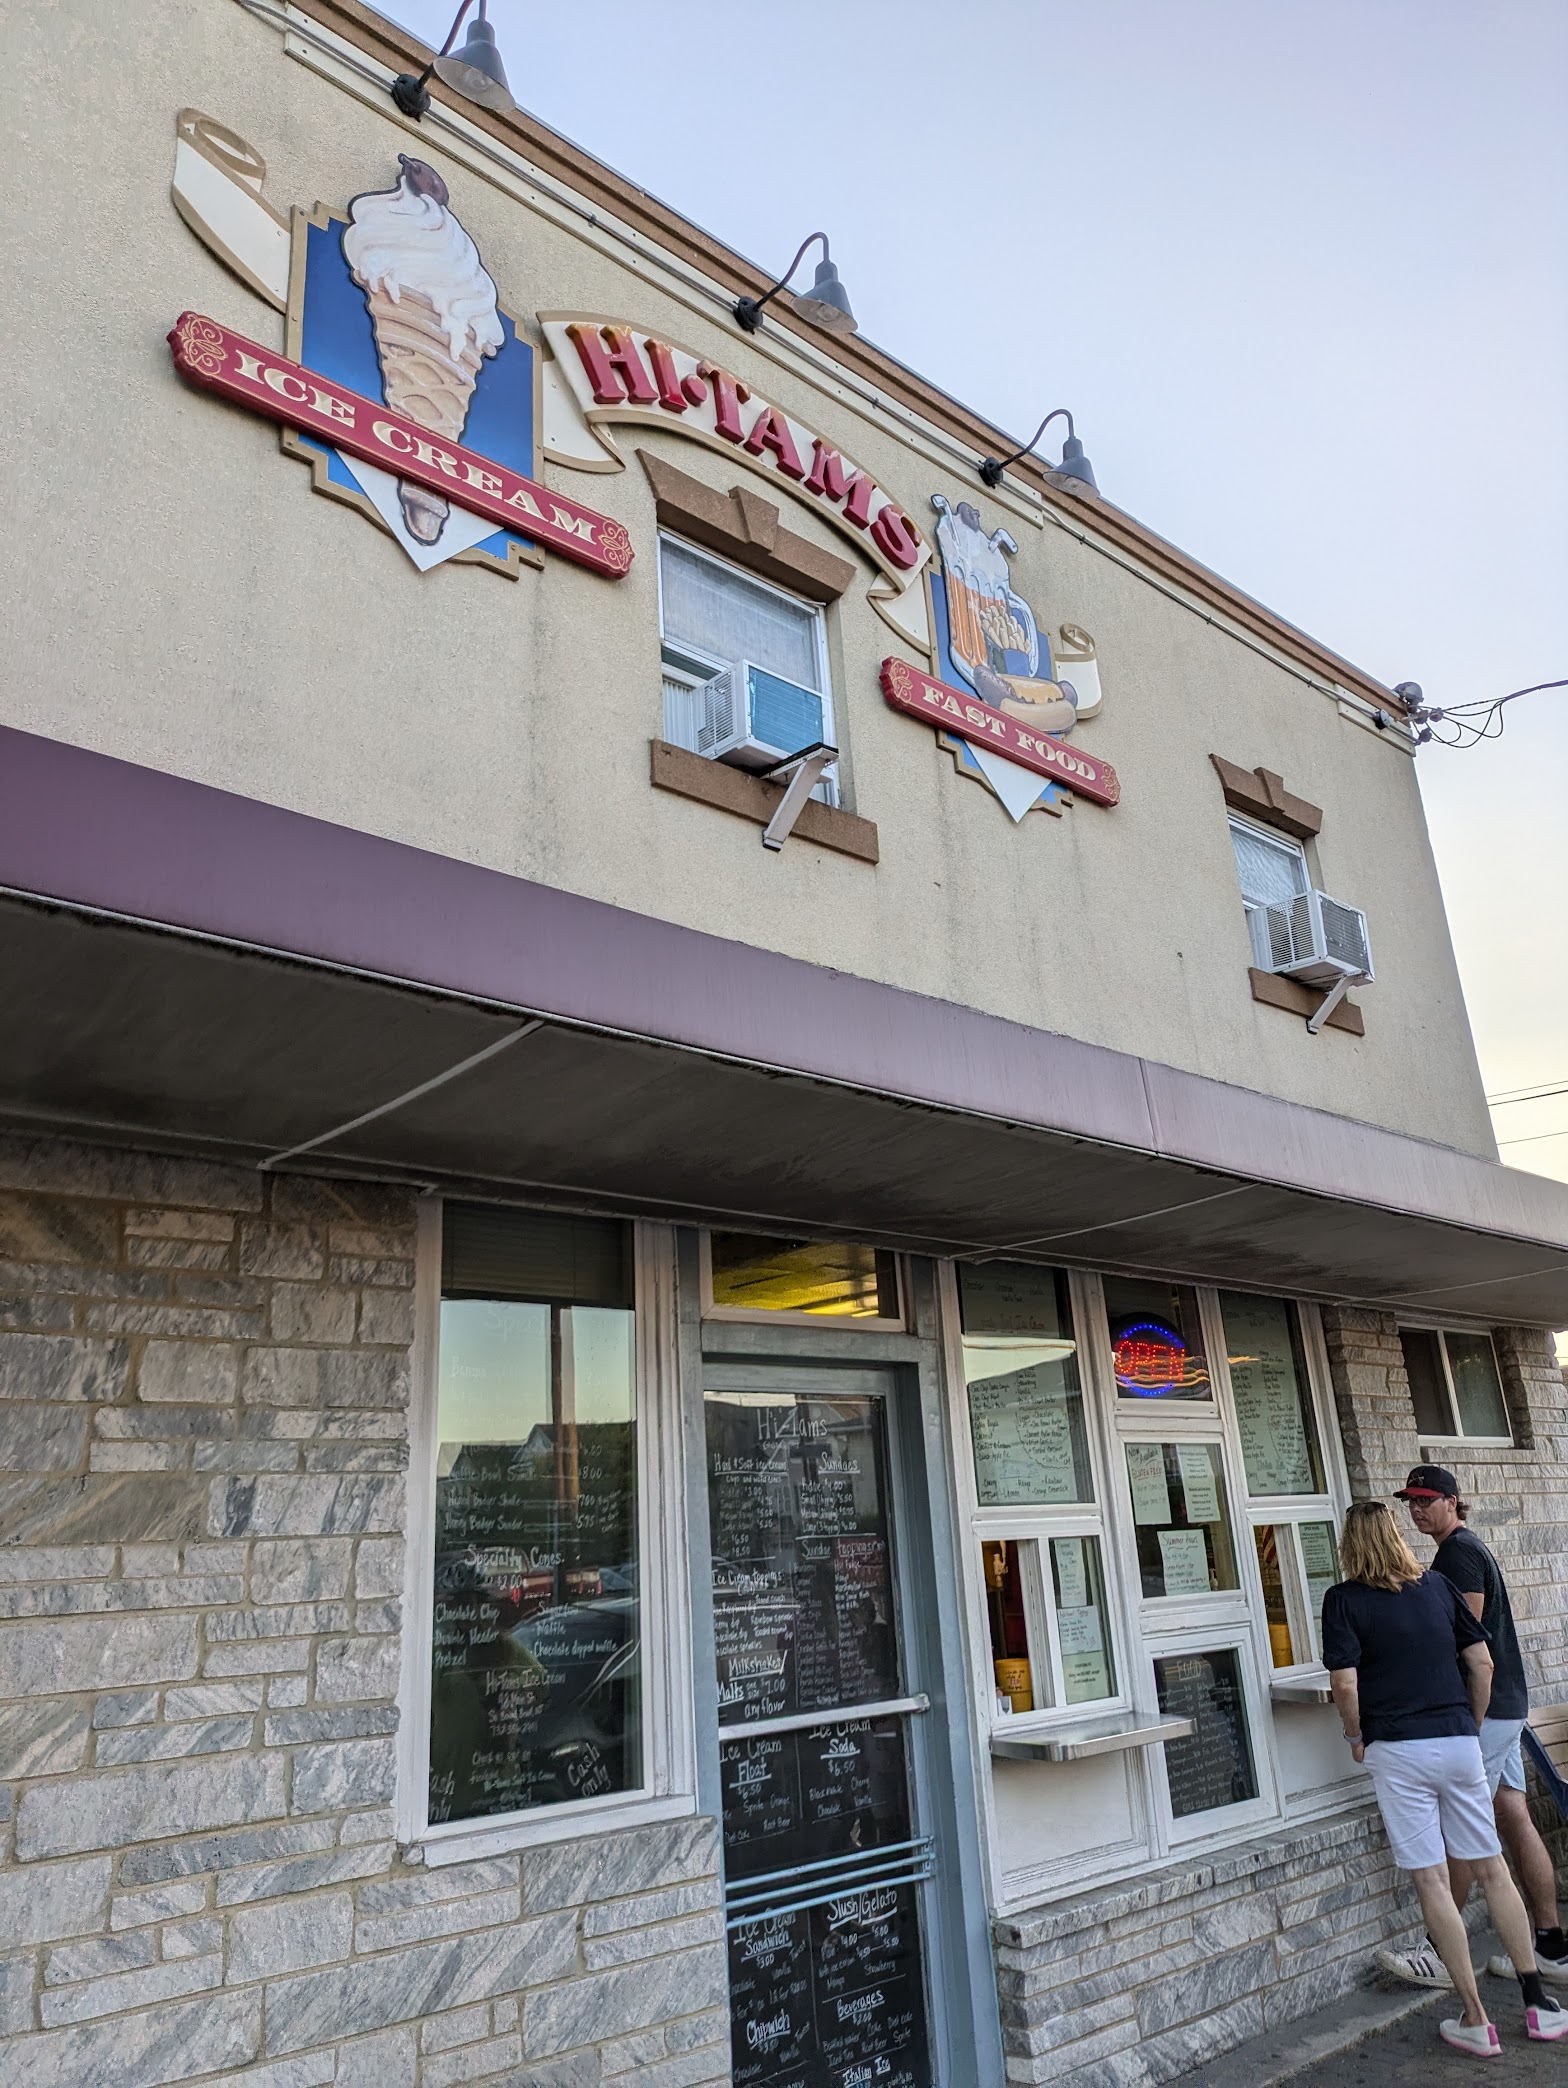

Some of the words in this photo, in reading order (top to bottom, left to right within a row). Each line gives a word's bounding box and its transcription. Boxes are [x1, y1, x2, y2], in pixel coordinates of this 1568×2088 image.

[232, 350, 355, 428] ICE
[374, 419, 598, 545] CREAM
[921, 682, 1006, 738] FAST
[1015, 729, 1097, 781] FOOD
[1119, 1340, 1184, 1381] OPEN
[819, 1451, 859, 1472] Sundaes
[1161, 1533, 1184, 1546] Summer
[465, 1544, 522, 1573] Specialty
[712, 1569, 727, 1587] Ice
[728, 1569, 751, 1587] Cream
[435, 1602, 477, 1622] Chocolate
[480, 1602, 500, 1624] Chip
[435, 1650, 467, 1669] Pretzel
[534, 1640, 570, 1658] Chocolate
[572, 1640, 595, 1658] dipped
[522, 1668, 540, 1688] Ice
[717, 1681, 744, 1703] Malts
[760, 1697, 786, 1717] flavor
[808, 1724, 832, 1740] Ice
[837, 1719, 871, 1738] Cream
[720, 1742, 741, 1763] Ice
[747, 1737, 783, 1760] Cream
[829, 1738, 857, 1754] Soda
[568, 1742, 600, 1787] Cash
[738, 1756, 768, 1782] Float
[828, 1759, 857, 1777] $6.50
[430, 1769, 456, 1796] ash
[581, 1764, 611, 1797] only
[851, 1776, 871, 1790] Cherry
[429, 1800, 453, 1823] nly
[743, 1800, 765, 1816] Sprite
[770, 1794, 791, 1809] Orange
[745, 1928, 790, 1957] Sandwich
[864, 1959, 897, 1977] Strawberry
[836, 1989, 885, 2019] Beverages
[746, 2008, 791, 2045] Chipwich
[842, 2065, 872, 2087] Italian
[874, 2055, 891, 2077] Ice
